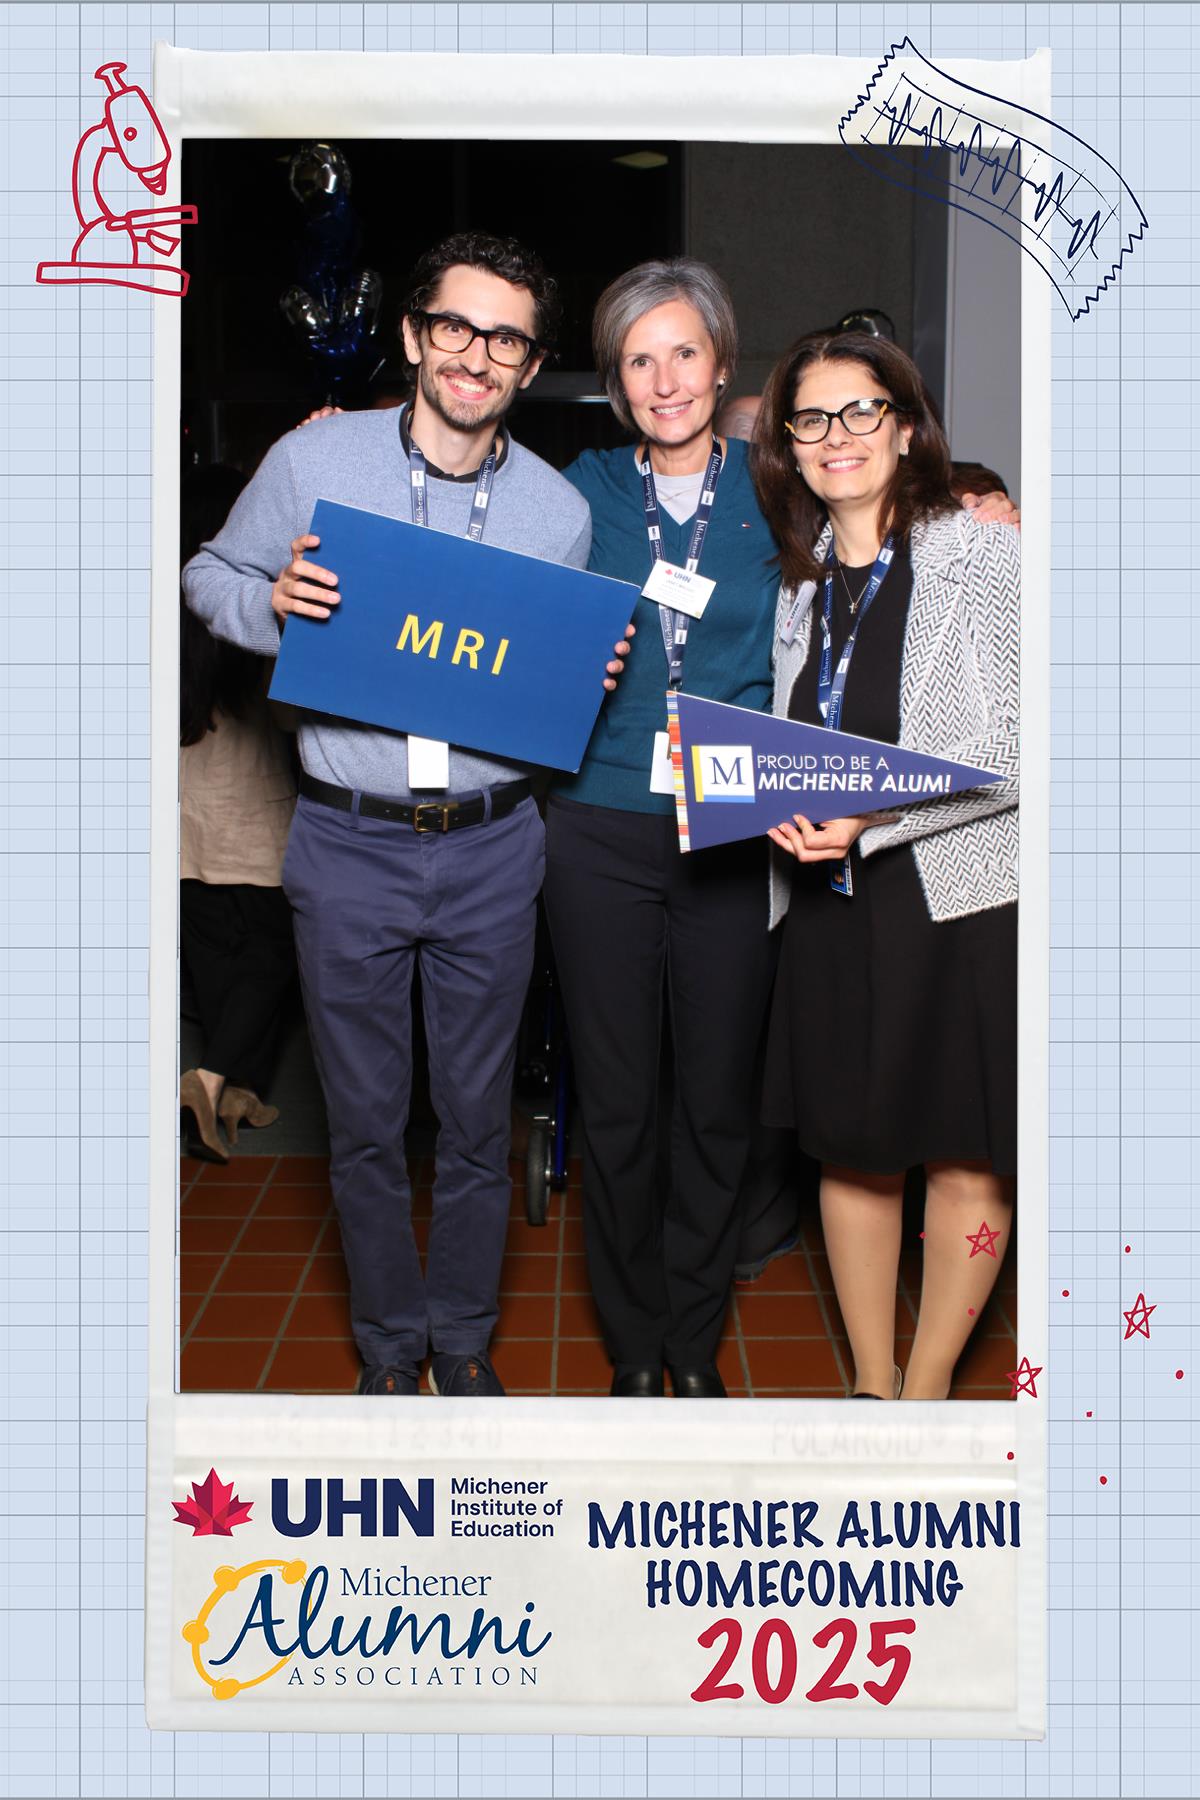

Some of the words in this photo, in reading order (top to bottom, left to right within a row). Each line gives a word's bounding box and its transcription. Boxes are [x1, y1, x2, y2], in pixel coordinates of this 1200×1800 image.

[706, 457, 721, 492] Michener
[645, 475, 654, 509] Michener
[690, 523, 705, 558] Michener
[674, 571, 692, 584] UHN
[396, 613, 510, 676] MRI
[664, 609, 672, 647] Michener
[829, 694, 839, 731] Michene
[709, 756, 746, 786] M
[757, 754, 818, 771] PROUD
[822, 754, 846, 771] TO
[850, 755, 871, 771] BE
[875, 756, 890, 771] A
[757, 772, 874, 792] MICHENER
[879, 774, 952, 793] ALUM!
